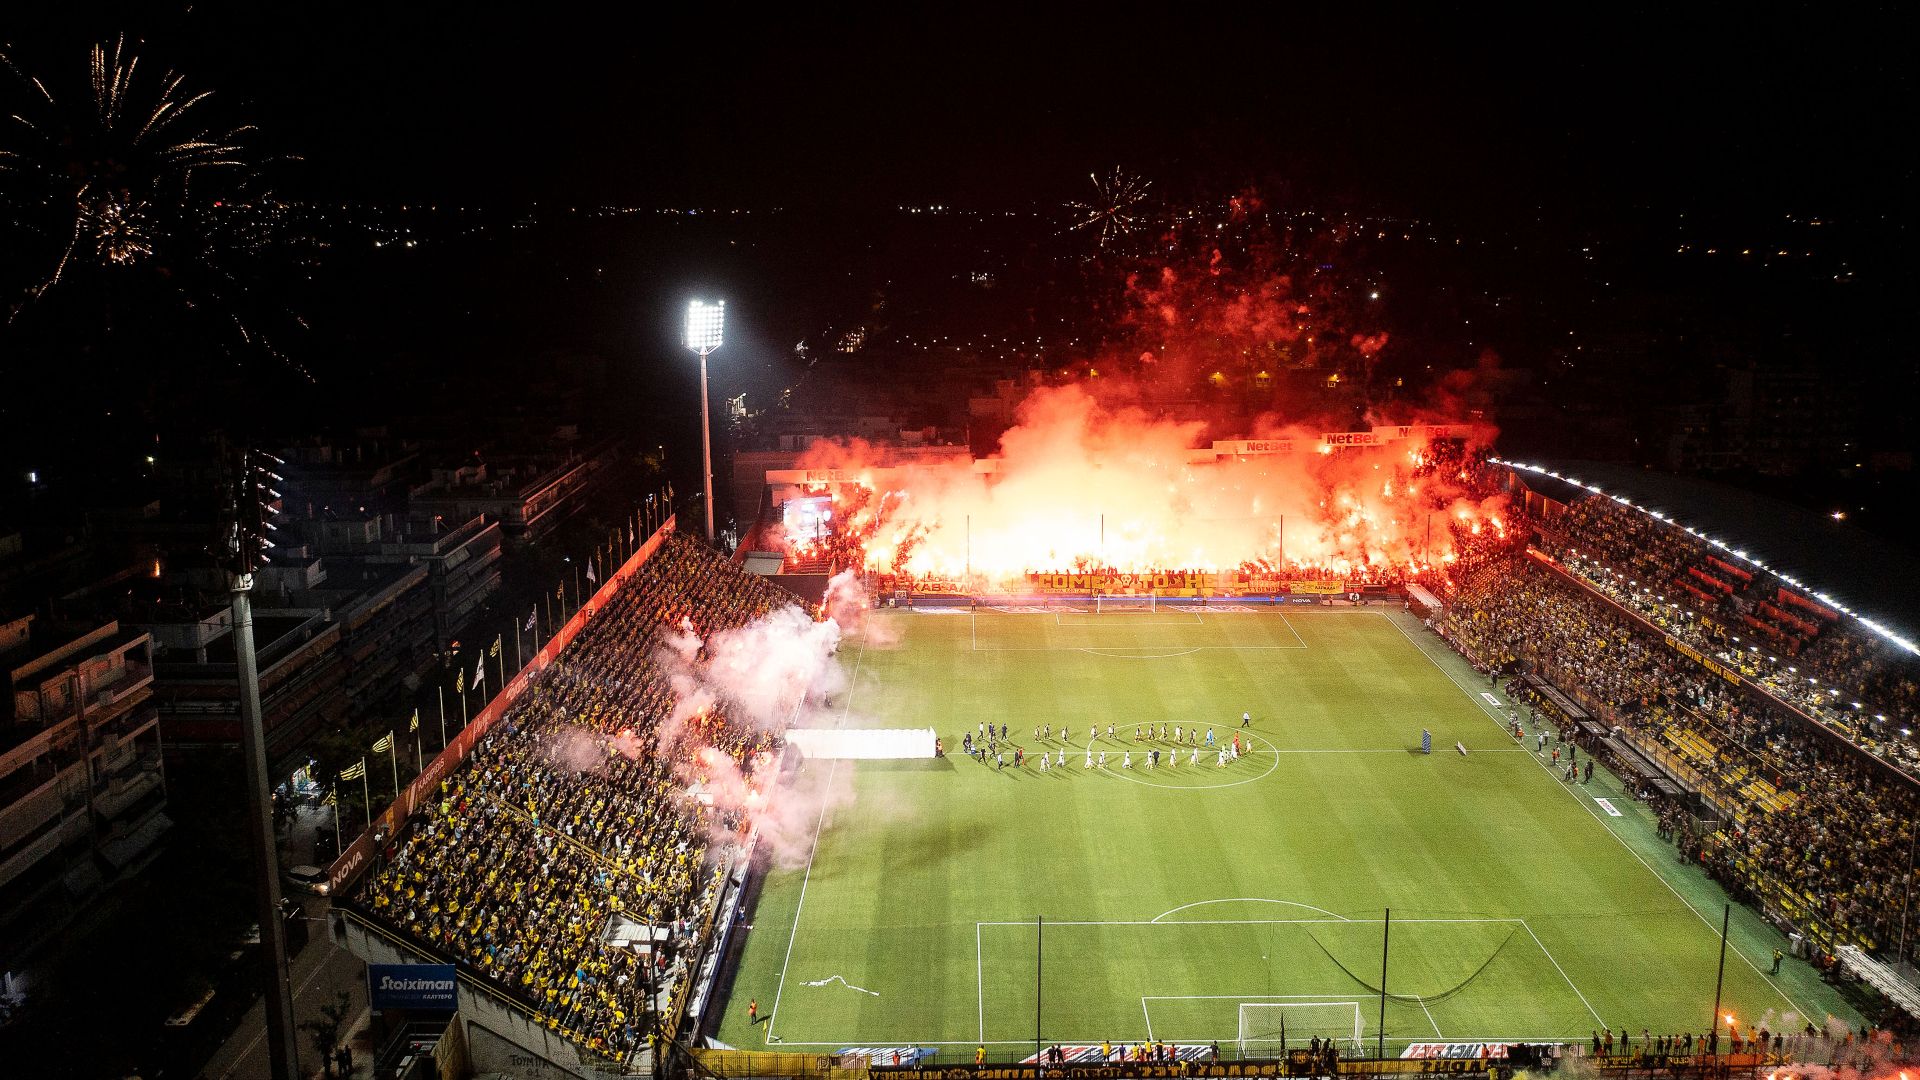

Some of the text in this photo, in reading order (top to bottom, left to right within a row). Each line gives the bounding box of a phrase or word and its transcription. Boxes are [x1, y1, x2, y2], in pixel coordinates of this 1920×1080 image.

[1246, 441, 1294, 452] NetBet
[1327, 433, 1378, 446] NetBet
[332, 850, 363, 890] NOVA
[379, 975, 455, 991] Stoiximan
